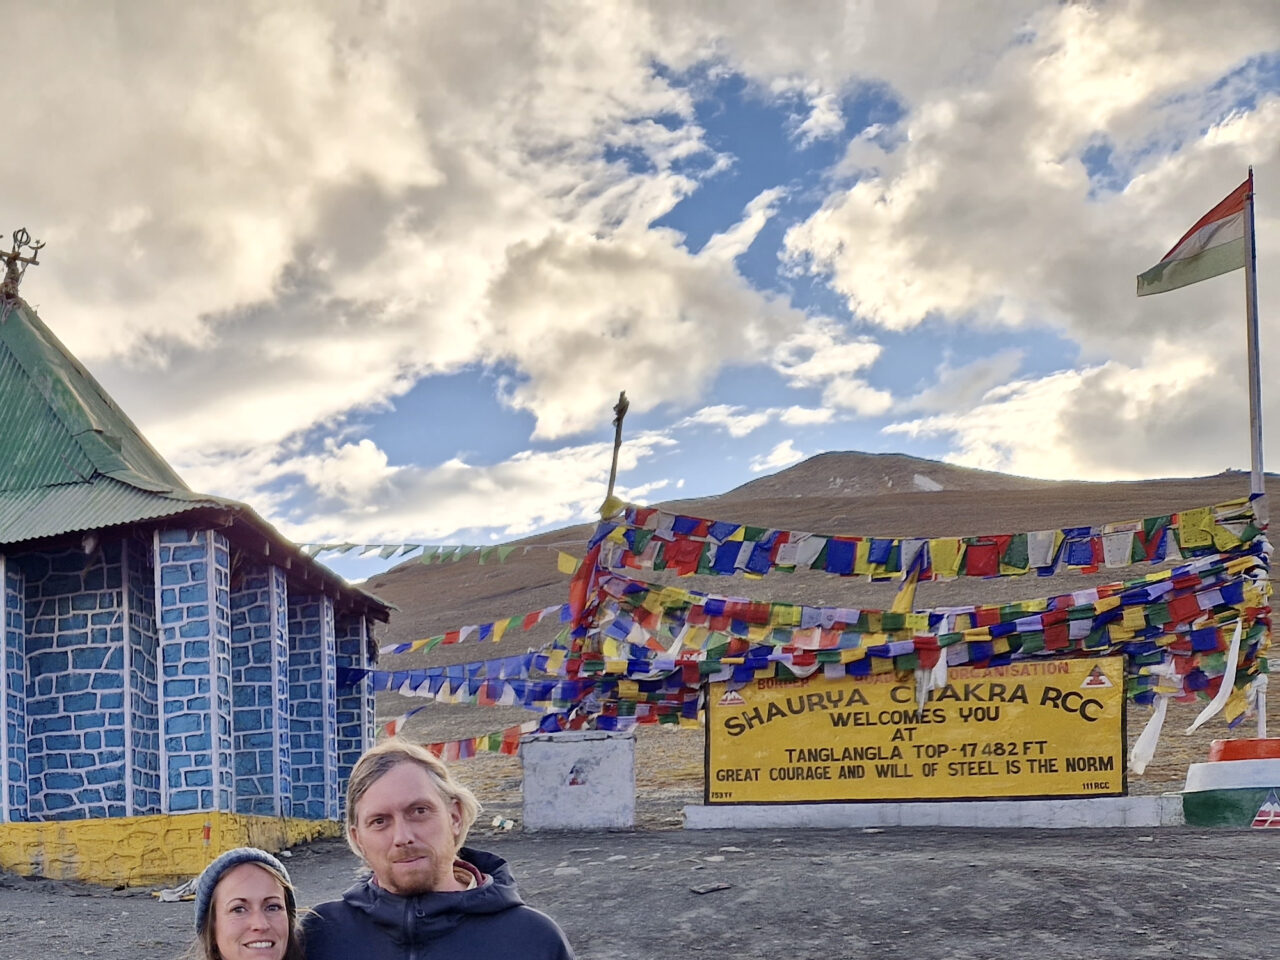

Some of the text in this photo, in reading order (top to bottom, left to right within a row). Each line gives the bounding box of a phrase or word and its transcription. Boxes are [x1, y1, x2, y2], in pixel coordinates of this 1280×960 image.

[950, 661, 1070, 681] ORGANISATION
[724, 688, 869, 737] SHAURYA
[1040, 686, 1104, 722] RCC
[829, 706, 1000, 728] WELCOMES YOU
[891, 728, 917, 742] AT
[785, 745, 904, 763] TANGLANGLA
[716, 756, 1115, 782] GREAT COURAGE AND WILL OF STEEL IS THE NORM
